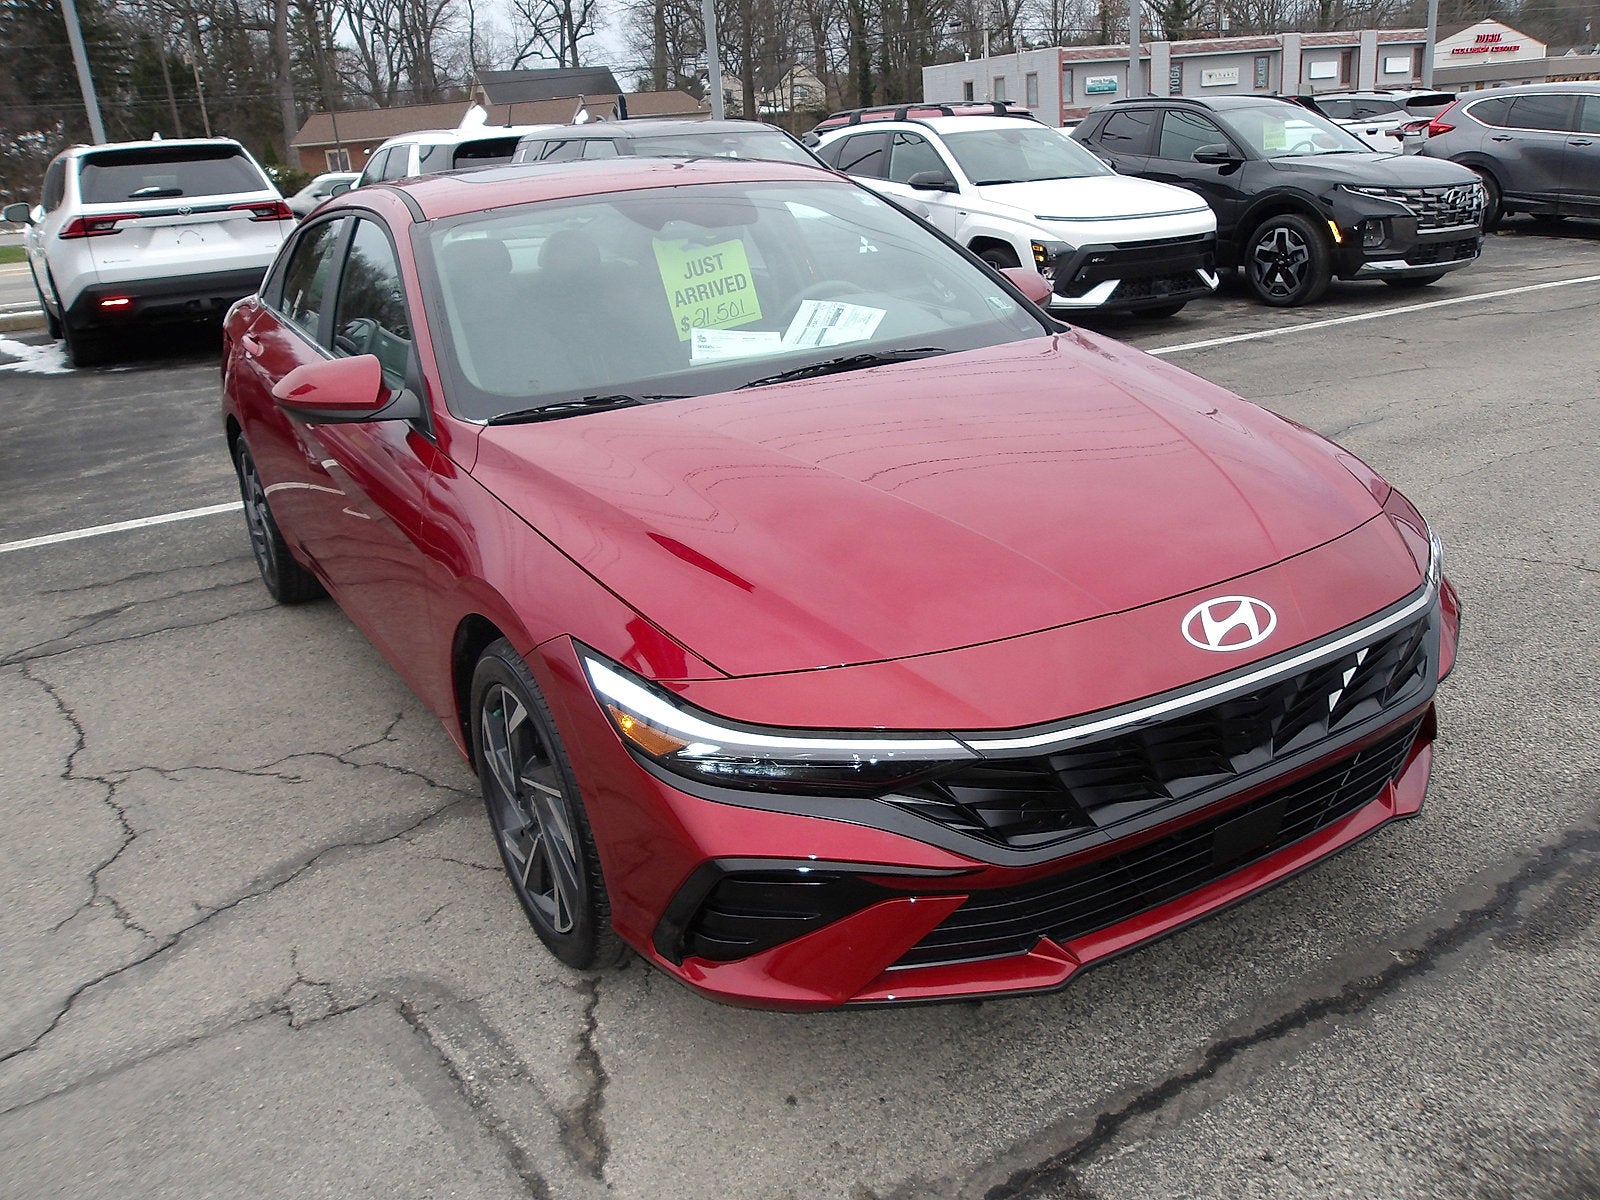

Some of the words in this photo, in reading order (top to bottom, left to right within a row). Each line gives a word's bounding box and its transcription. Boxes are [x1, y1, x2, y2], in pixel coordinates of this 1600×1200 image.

[1169, 65, 1180, 92] YOGA
[683, 253, 724, 280] JUST
[674, 273, 747, 308] ARRIVED
